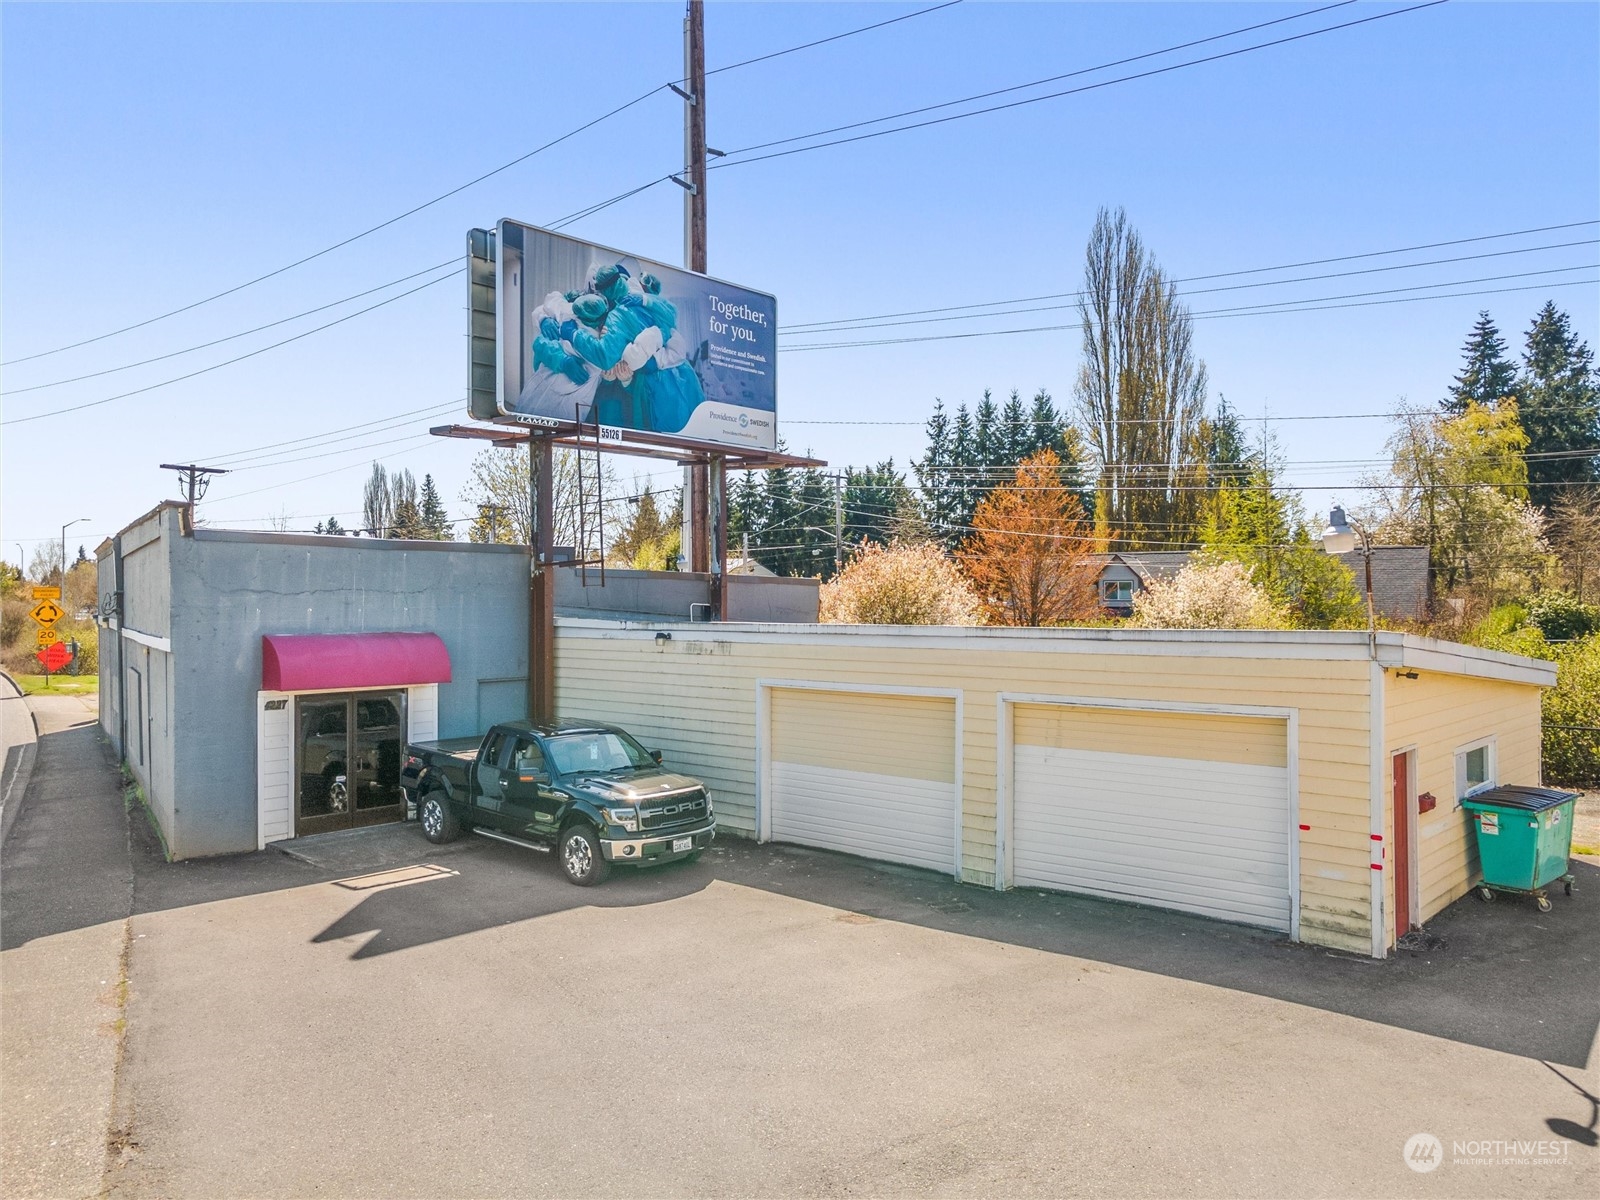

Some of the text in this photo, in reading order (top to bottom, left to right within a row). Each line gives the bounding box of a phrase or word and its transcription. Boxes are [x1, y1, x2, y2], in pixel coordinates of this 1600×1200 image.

[709, 295, 767, 328] Together,
[709, 315, 756, 342] for you.
[710, 344, 737, 356] Providence
[520, 416, 556, 427] LAMAR
[709, 410, 770, 428] Providence SWEDISH
[601, 428, 620, 440] 55126
[40, 631, 55, 639] 20
[641, 799, 705, 819] FORD
